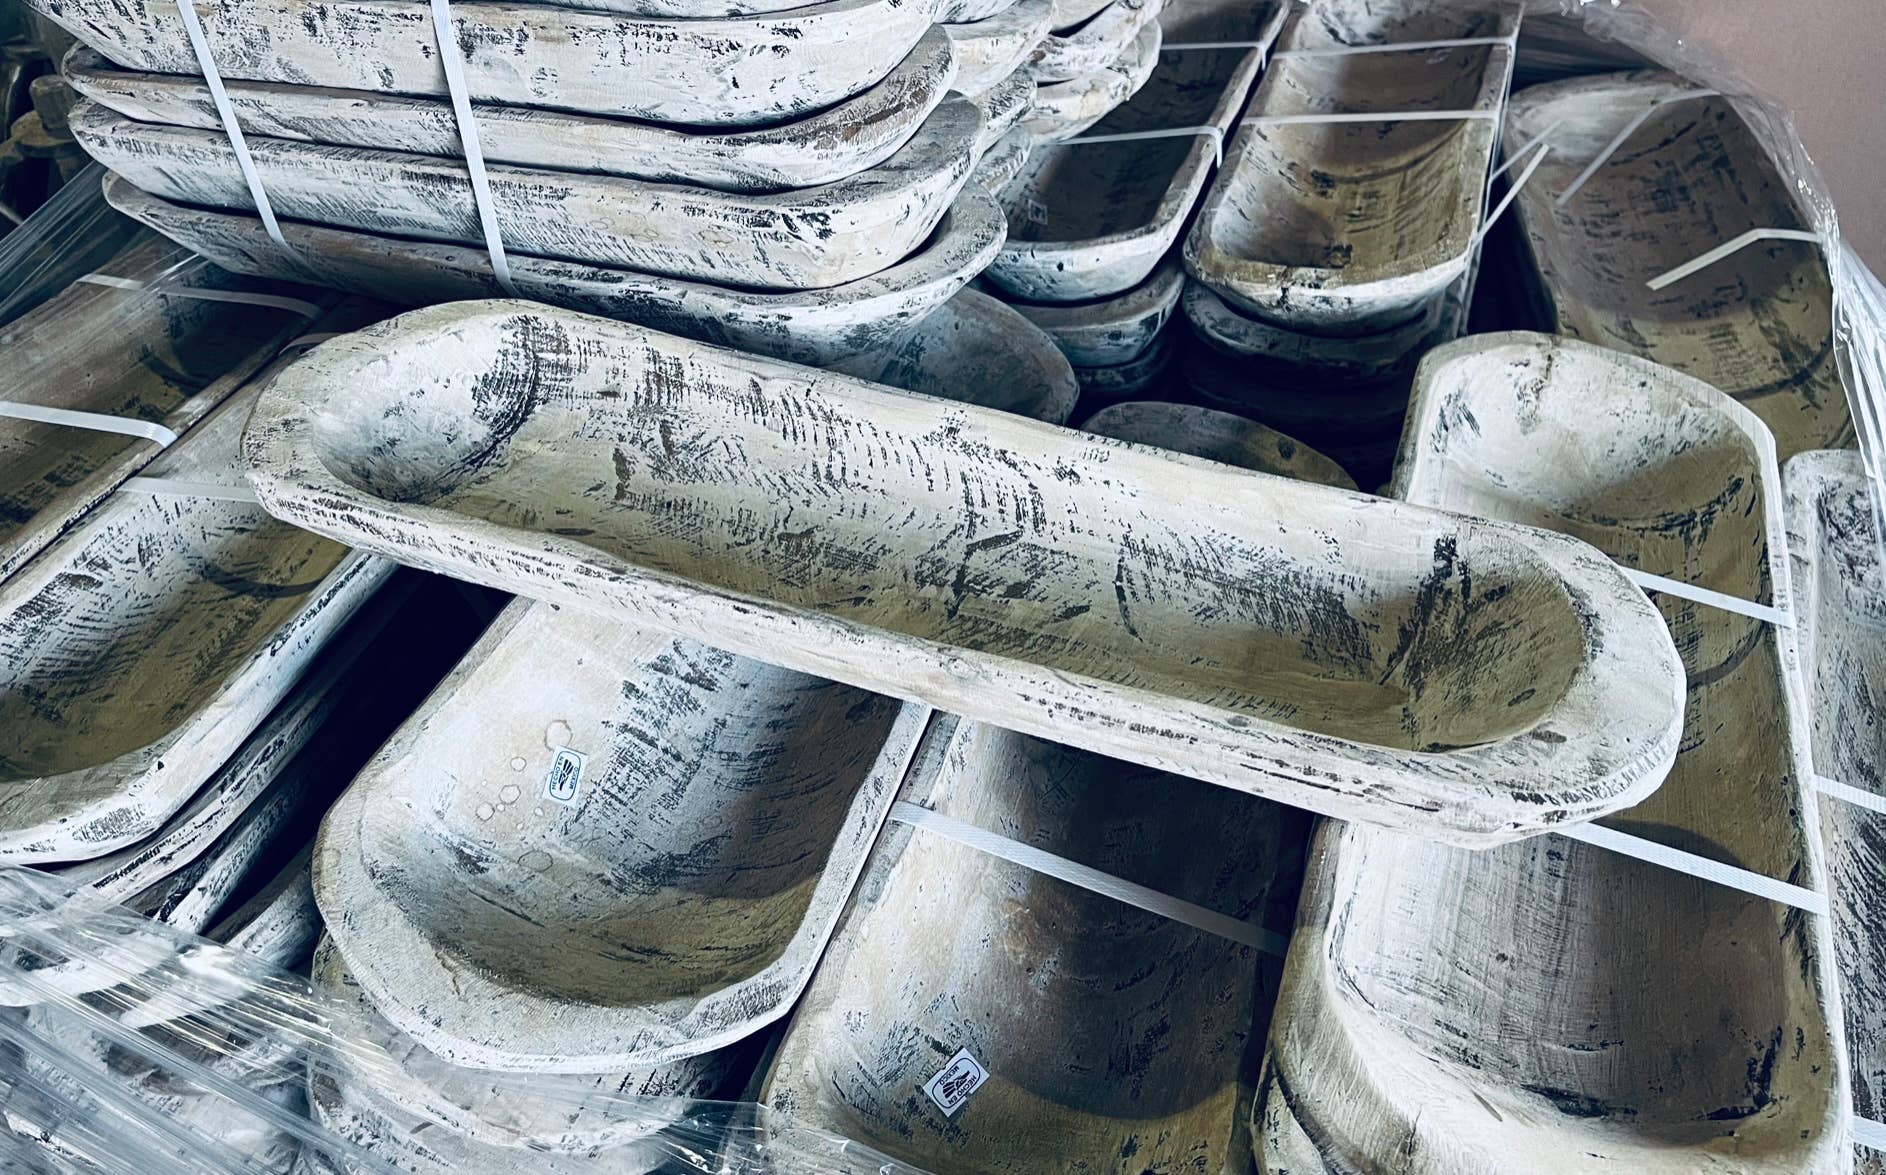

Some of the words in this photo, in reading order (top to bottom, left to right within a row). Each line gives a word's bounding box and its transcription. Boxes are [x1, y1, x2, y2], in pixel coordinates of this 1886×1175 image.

[551, 766, 561, 790] HECHO
[569, 766, 579, 790] MEXICO
[939, 1065, 960, 1086] MEXICO
[957, 1075, 977, 1097] HECHO
[947, 1095, 958, 1105] EN
